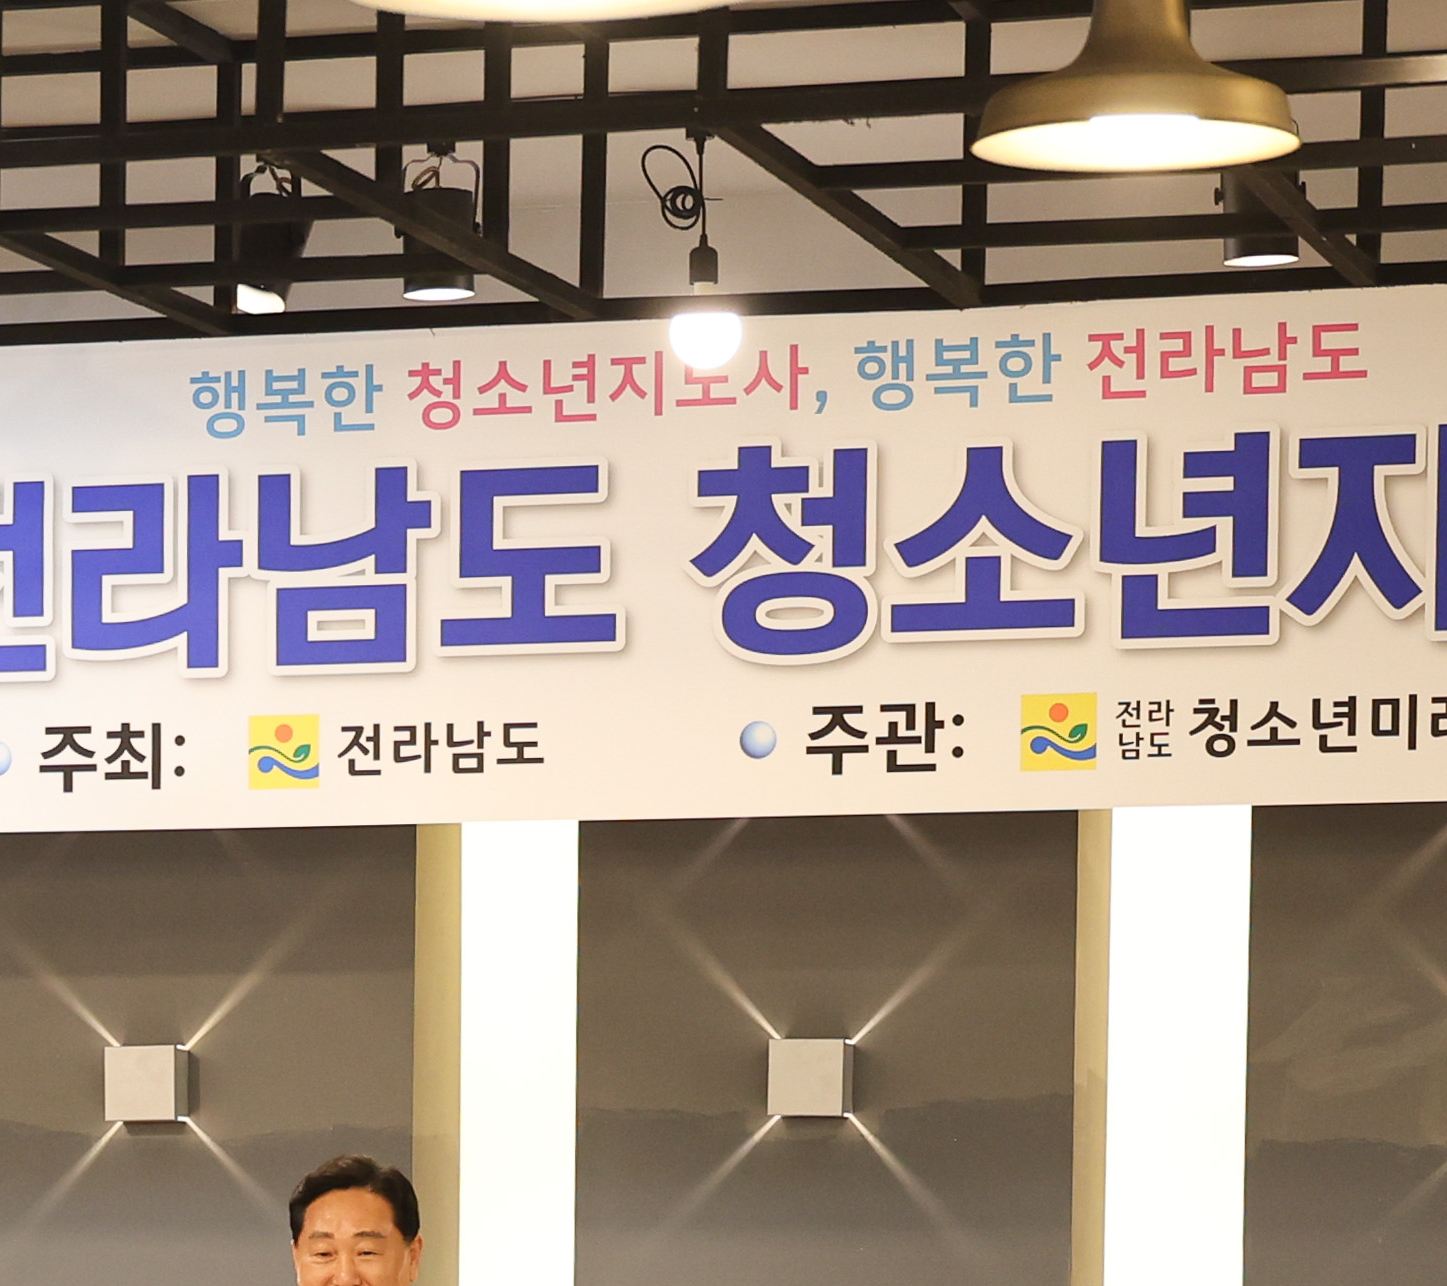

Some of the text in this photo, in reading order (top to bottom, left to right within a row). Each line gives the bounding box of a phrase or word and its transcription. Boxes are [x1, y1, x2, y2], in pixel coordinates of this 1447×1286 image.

[189, 363, 383, 440] 행복한
[853, 332, 1062, 412] 행복한
[1086, 321, 1369, 400] 전라남도
[804, 702, 966, 776] 주관:
[1115, 699, 1176, 729] 전라
[1116, 730, 1174, 760] 남도
[38, 720, 545, 793] 주최: 전라남도
